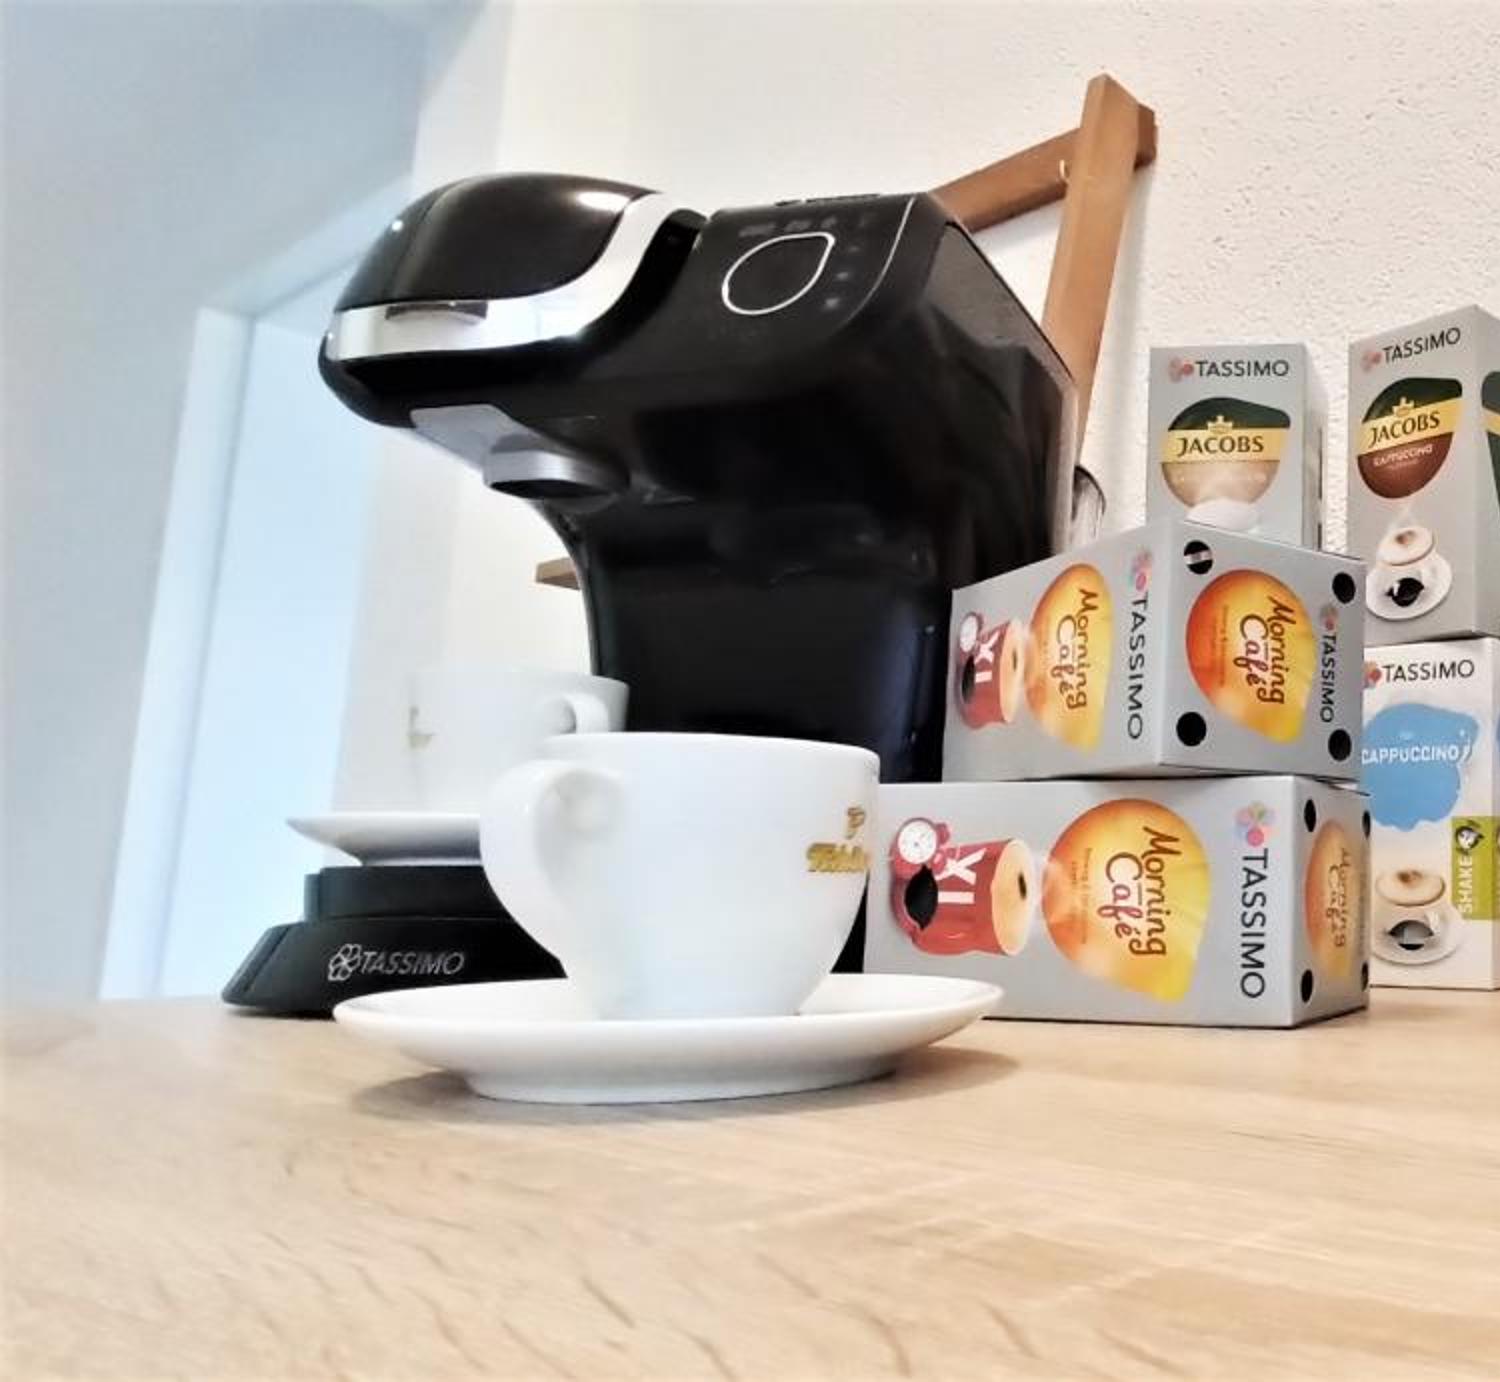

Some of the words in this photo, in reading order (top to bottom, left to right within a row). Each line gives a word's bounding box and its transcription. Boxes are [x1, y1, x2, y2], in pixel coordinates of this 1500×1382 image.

[1195, 360, 1290, 377] TASSIMO
[1382, 327, 1461, 364] TASSIMO
[1177, 435, 1264, 457] JACOBS
[1368, 410, 1441, 448] JACOBS
[1050, 613, 1077, 696] Café
[1066, 588, 1099, 711] Morning
[1127, 592, 1149, 740] TASSIMO
[1232, 613, 1269, 687] Café
[1256, 595, 1297, 704] Morning
[1320, 633, 1338, 723] TASSIMO
[1382, 659, 1475, 682] TASSIMO
[1361, 744, 1459, 765] CAPPUCCINO
[1097, 851, 1144, 938] Café
[1128, 825, 1182, 956] Morning
[1458, 855, 1472, 913] SHAKE
[1239, 847, 1269, 999] TASSIMO
[361, 951, 465, 975] TASSIMO
